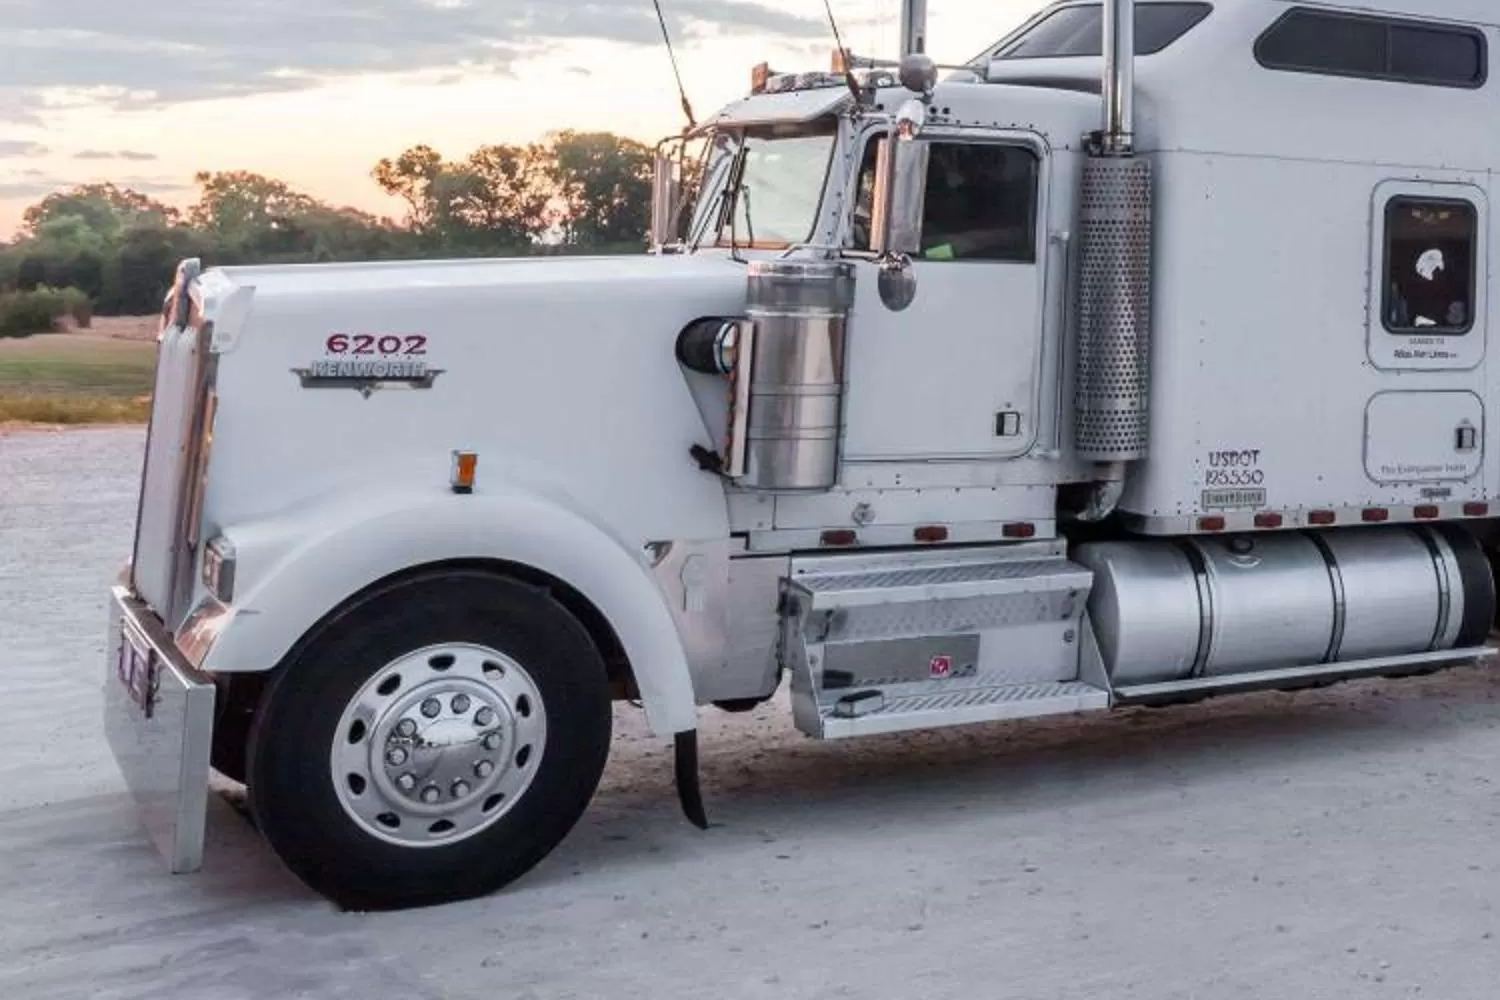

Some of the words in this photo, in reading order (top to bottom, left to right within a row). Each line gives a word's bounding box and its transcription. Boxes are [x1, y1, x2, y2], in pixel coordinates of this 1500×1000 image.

[327, 333, 428, 355] 6202
[311, 360, 428, 377] KENWORTH
[1208, 449, 1261, 468] USDOT
